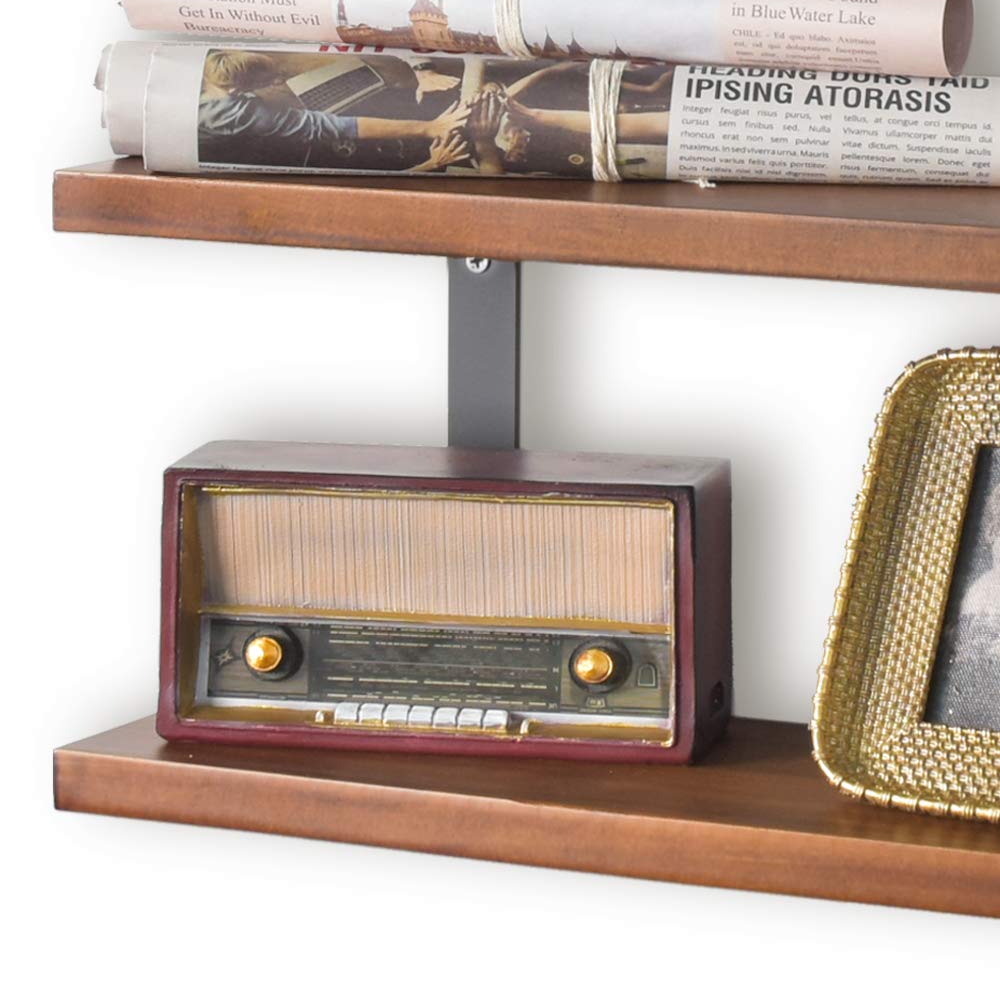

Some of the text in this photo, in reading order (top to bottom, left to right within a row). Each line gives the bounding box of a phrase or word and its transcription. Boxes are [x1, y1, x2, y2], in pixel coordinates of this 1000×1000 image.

[178, 5, 320, 26] Get In Without Evil
[732, 3, 876, 26] in Blue Water Lake
[732, 29, 760, 38] CHILE
[686, 78, 952, 114] IPISING ATORASIS
[682, 105, 712, 115] Integer
[720, 107, 749, 117] feugiat
[785, 112, 812, 121] purus,
[745, 121, 774, 130] finibus
[809, 125, 831, 134] Nulla
[844, 115, 868, 124] tellus,
[888, 118, 918, 127] congue
[924, 120, 940, 128] orci
[945, 121, 977, 130] tempus
[680, 130, 715, 140] rhoncus
[795, 138, 830, 146] pulvinar
[843, 128, 992, 144] Vivamus ullamcorper mattis dui
[747, 148, 776, 156] viverra
[800, 150, 829, 159] Mauris
[842, 140, 862, 149] vitae
[906, 144, 959, 154] Suspendisse
[679, 155, 716, 163] euismod
[748, 158, 766, 166] felis
[769, 160, 786, 168] quis
[841, 152, 896, 162] pellentesque
[938, 158, 964, 167] Donec
[972, 161, 990, 169] eget
